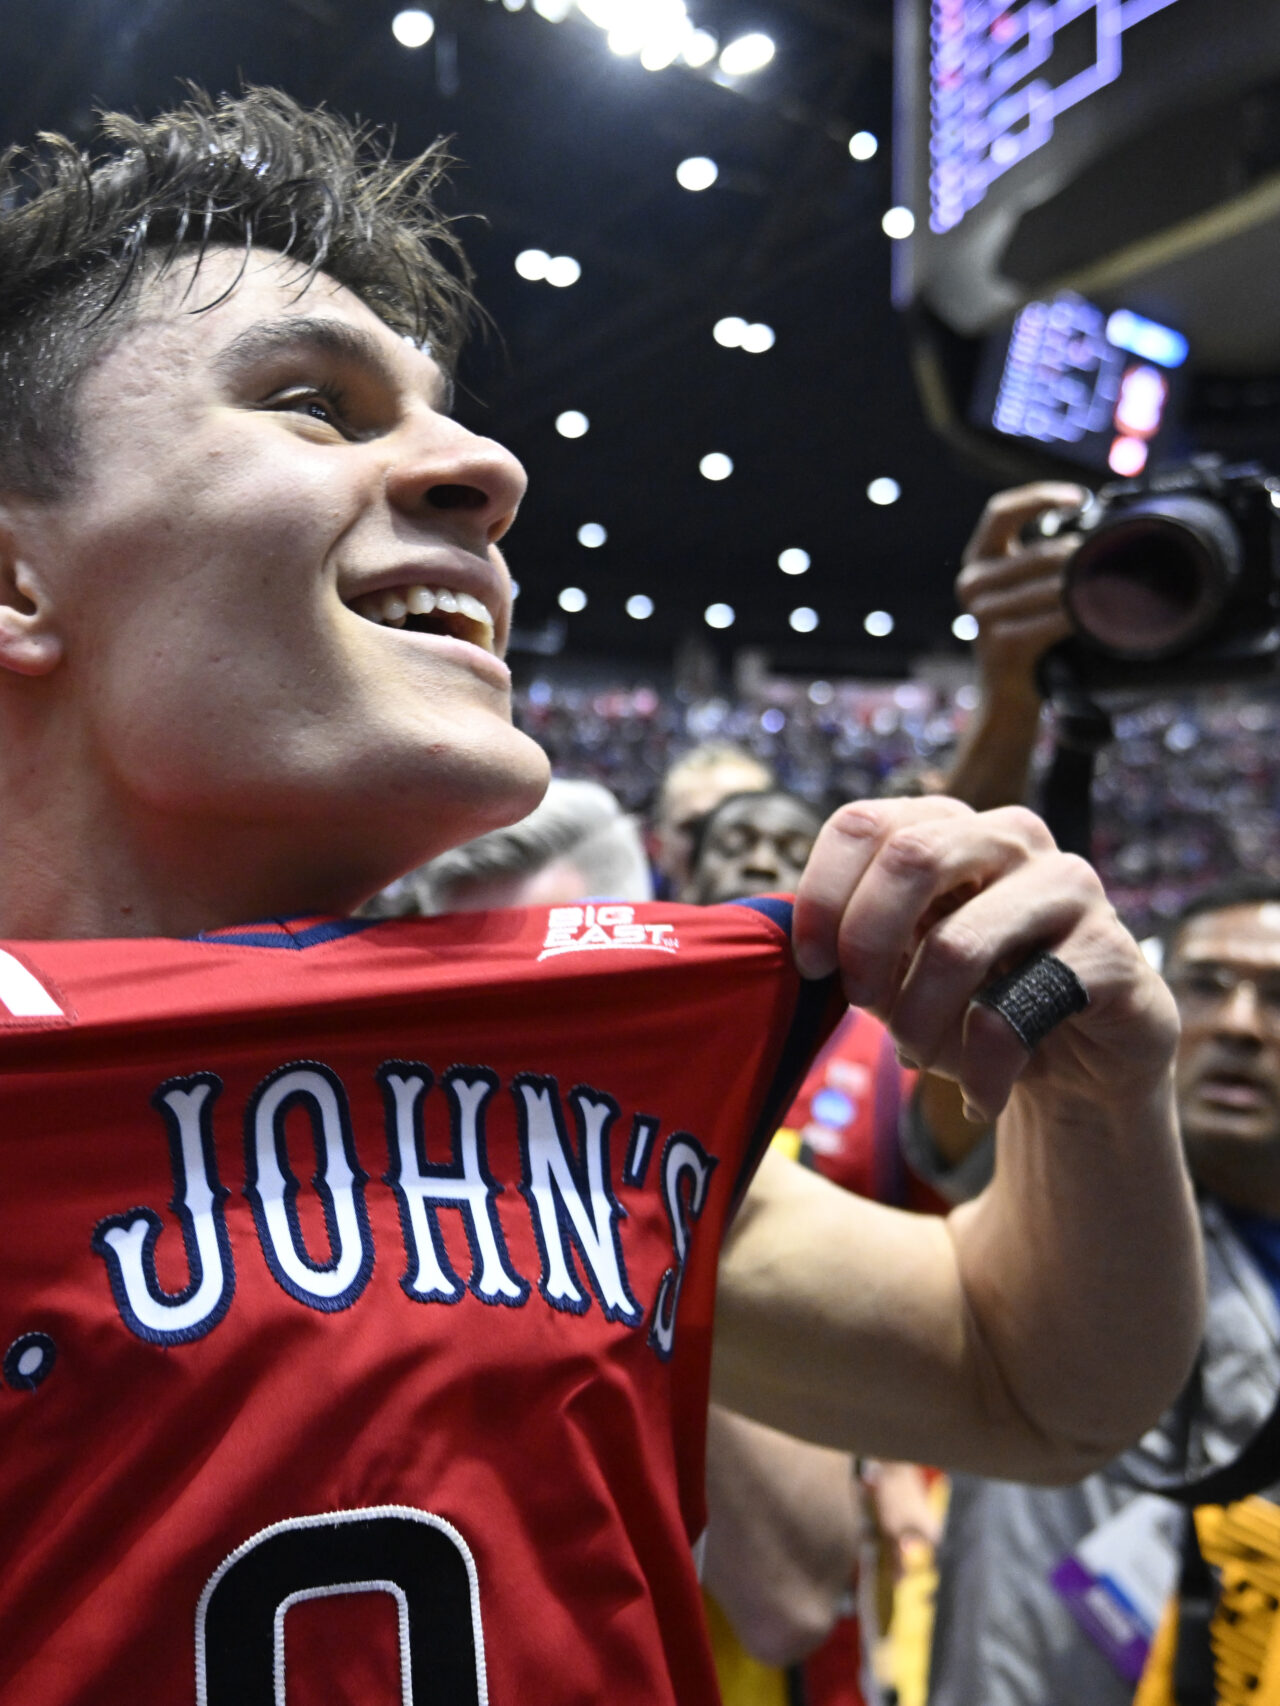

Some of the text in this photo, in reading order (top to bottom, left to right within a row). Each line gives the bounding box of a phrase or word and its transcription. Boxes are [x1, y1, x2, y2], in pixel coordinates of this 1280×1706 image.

[548, 905, 635, 927] BIG
[543, 924, 674, 947] EAST
[91, 1060, 718, 1361] JOHN'S
